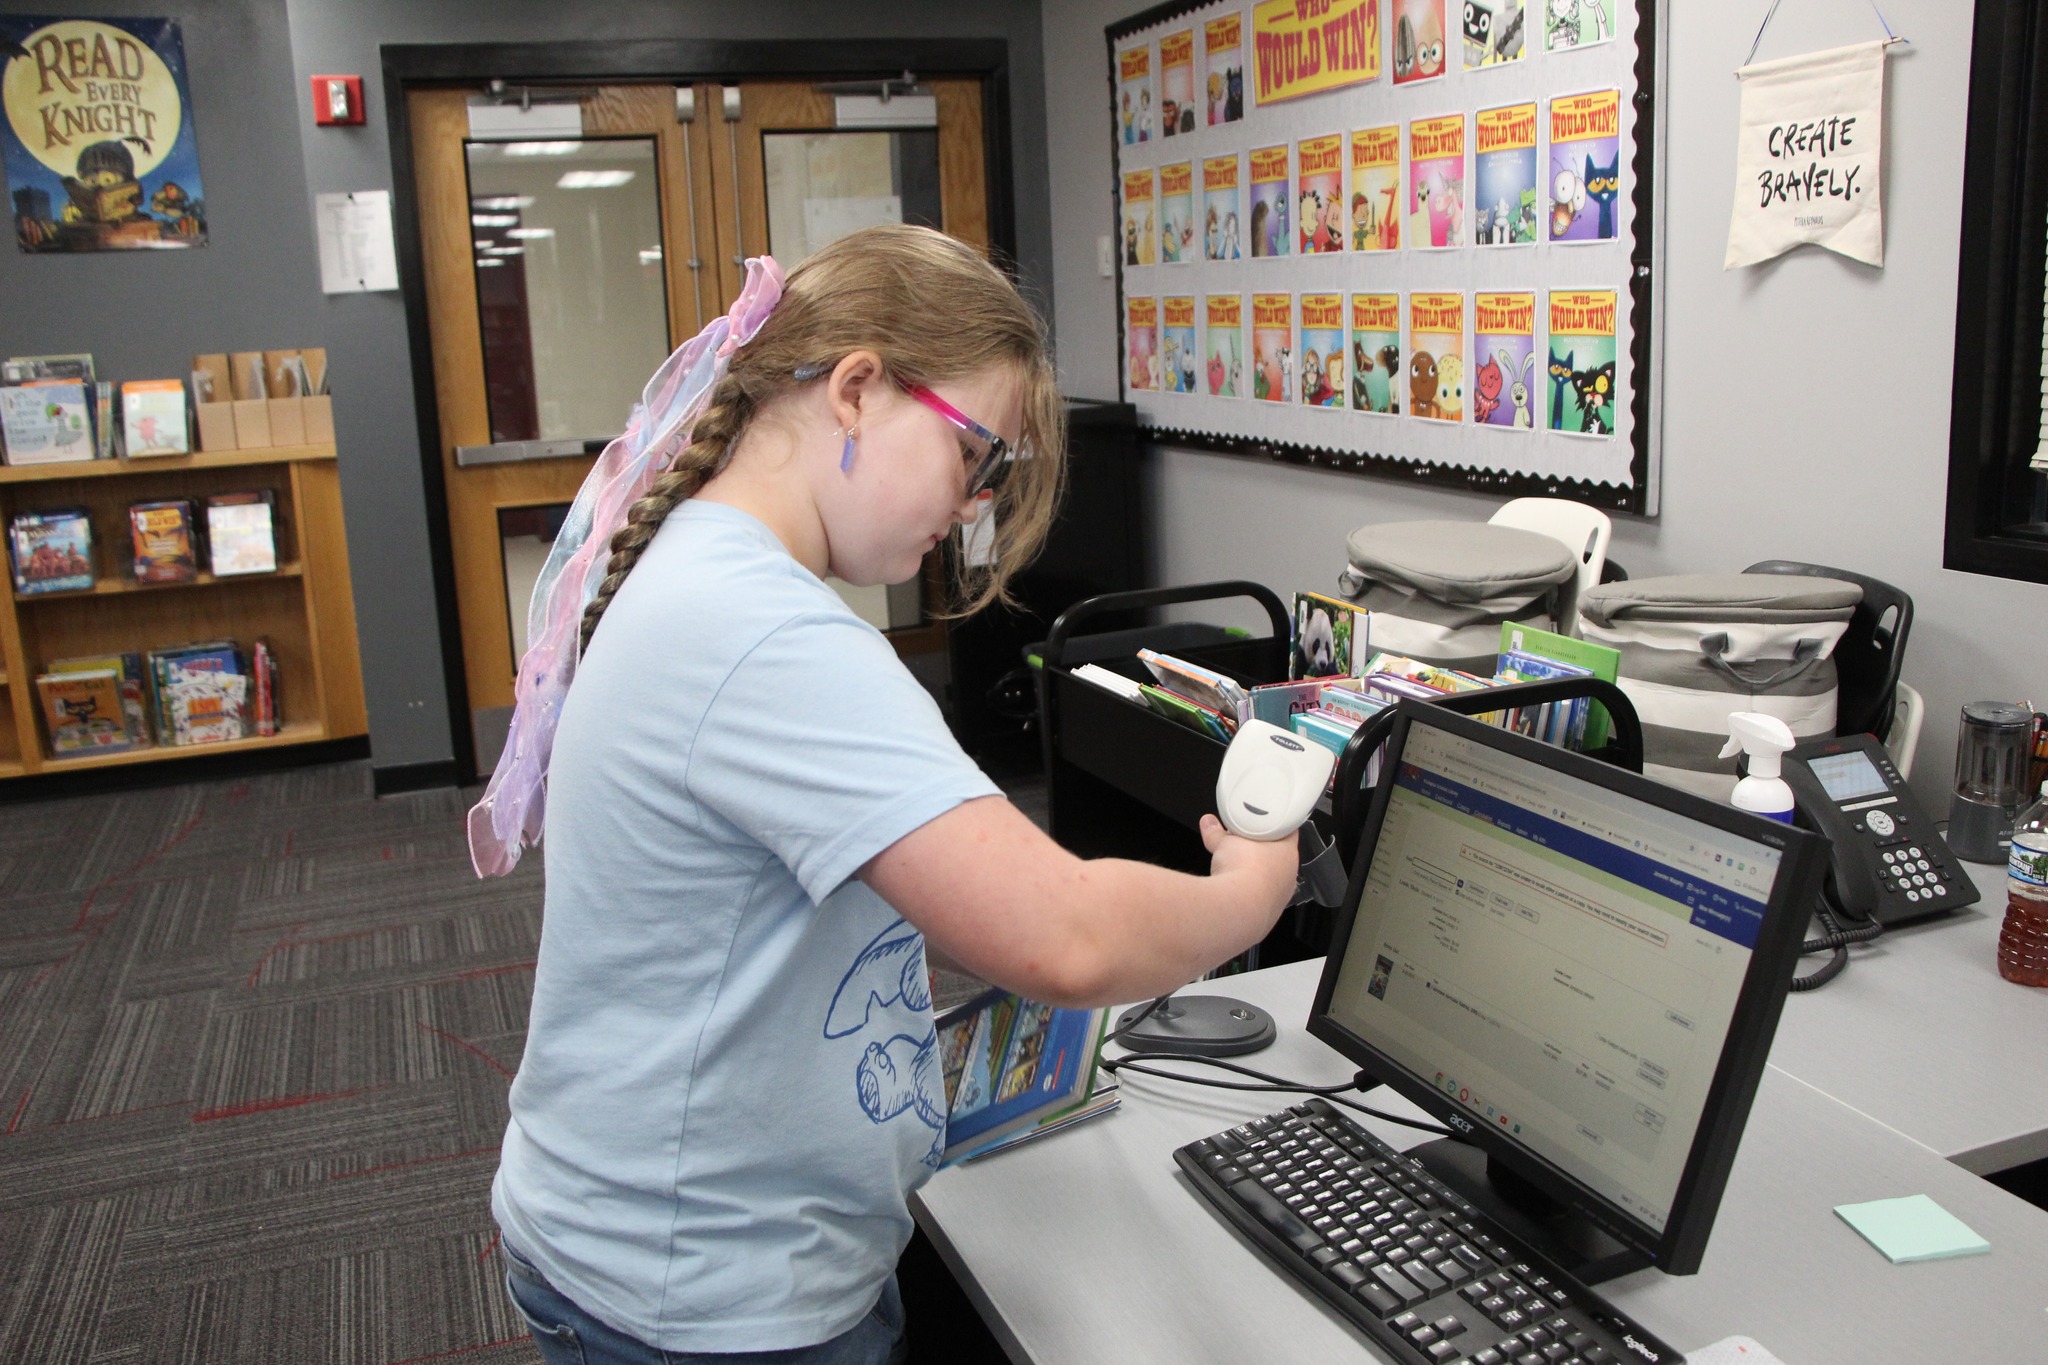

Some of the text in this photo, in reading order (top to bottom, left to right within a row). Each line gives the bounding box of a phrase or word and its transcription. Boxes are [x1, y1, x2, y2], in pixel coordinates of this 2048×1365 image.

[1256, 0, 1377, 98] WOULD WIN?
[32, 32, 145, 95] READ
[85, 80, 142, 103] EVERY
[1496, 111, 1512, 121] WHO
[1573, 98, 1592, 110] WHO
[39, 101, 157, 150] KNIGHT
[1427, 121, 1443, 132] WHO
[1478, 114, 1535, 151] WOULD WIN?
[1552, 102, 1617, 141] WOULD WIN?
[1367, 132, 1380, 141] WHO
[1411, 126, 1462, 159] WOULD WIN?
[1768, 115, 1857, 160] CREATE
[1353, 143, 1377, 167] WOULD
[1758, 162, 1861, 208] BRAVELY.
[1367, 297, 1380, 306] WHO
[1428, 297, 1443, 306] WHO
[1494, 297, 1511, 306] WHO
[1572, 295, 1590, 305] WHO
[1353, 305, 1377, 328] WOULD
[1412, 304, 1461, 331] WOULD WIN?
[1477, 304, 1533, 332] WOULD WIN?
[1551, 303, 1614, 333] WOULD WIN?
[1274, 736, 1300, 750] FOLLETT
[1449, 1113, 1474, 1135] acer
[1622, 1334, 1659, 1362] logitech
